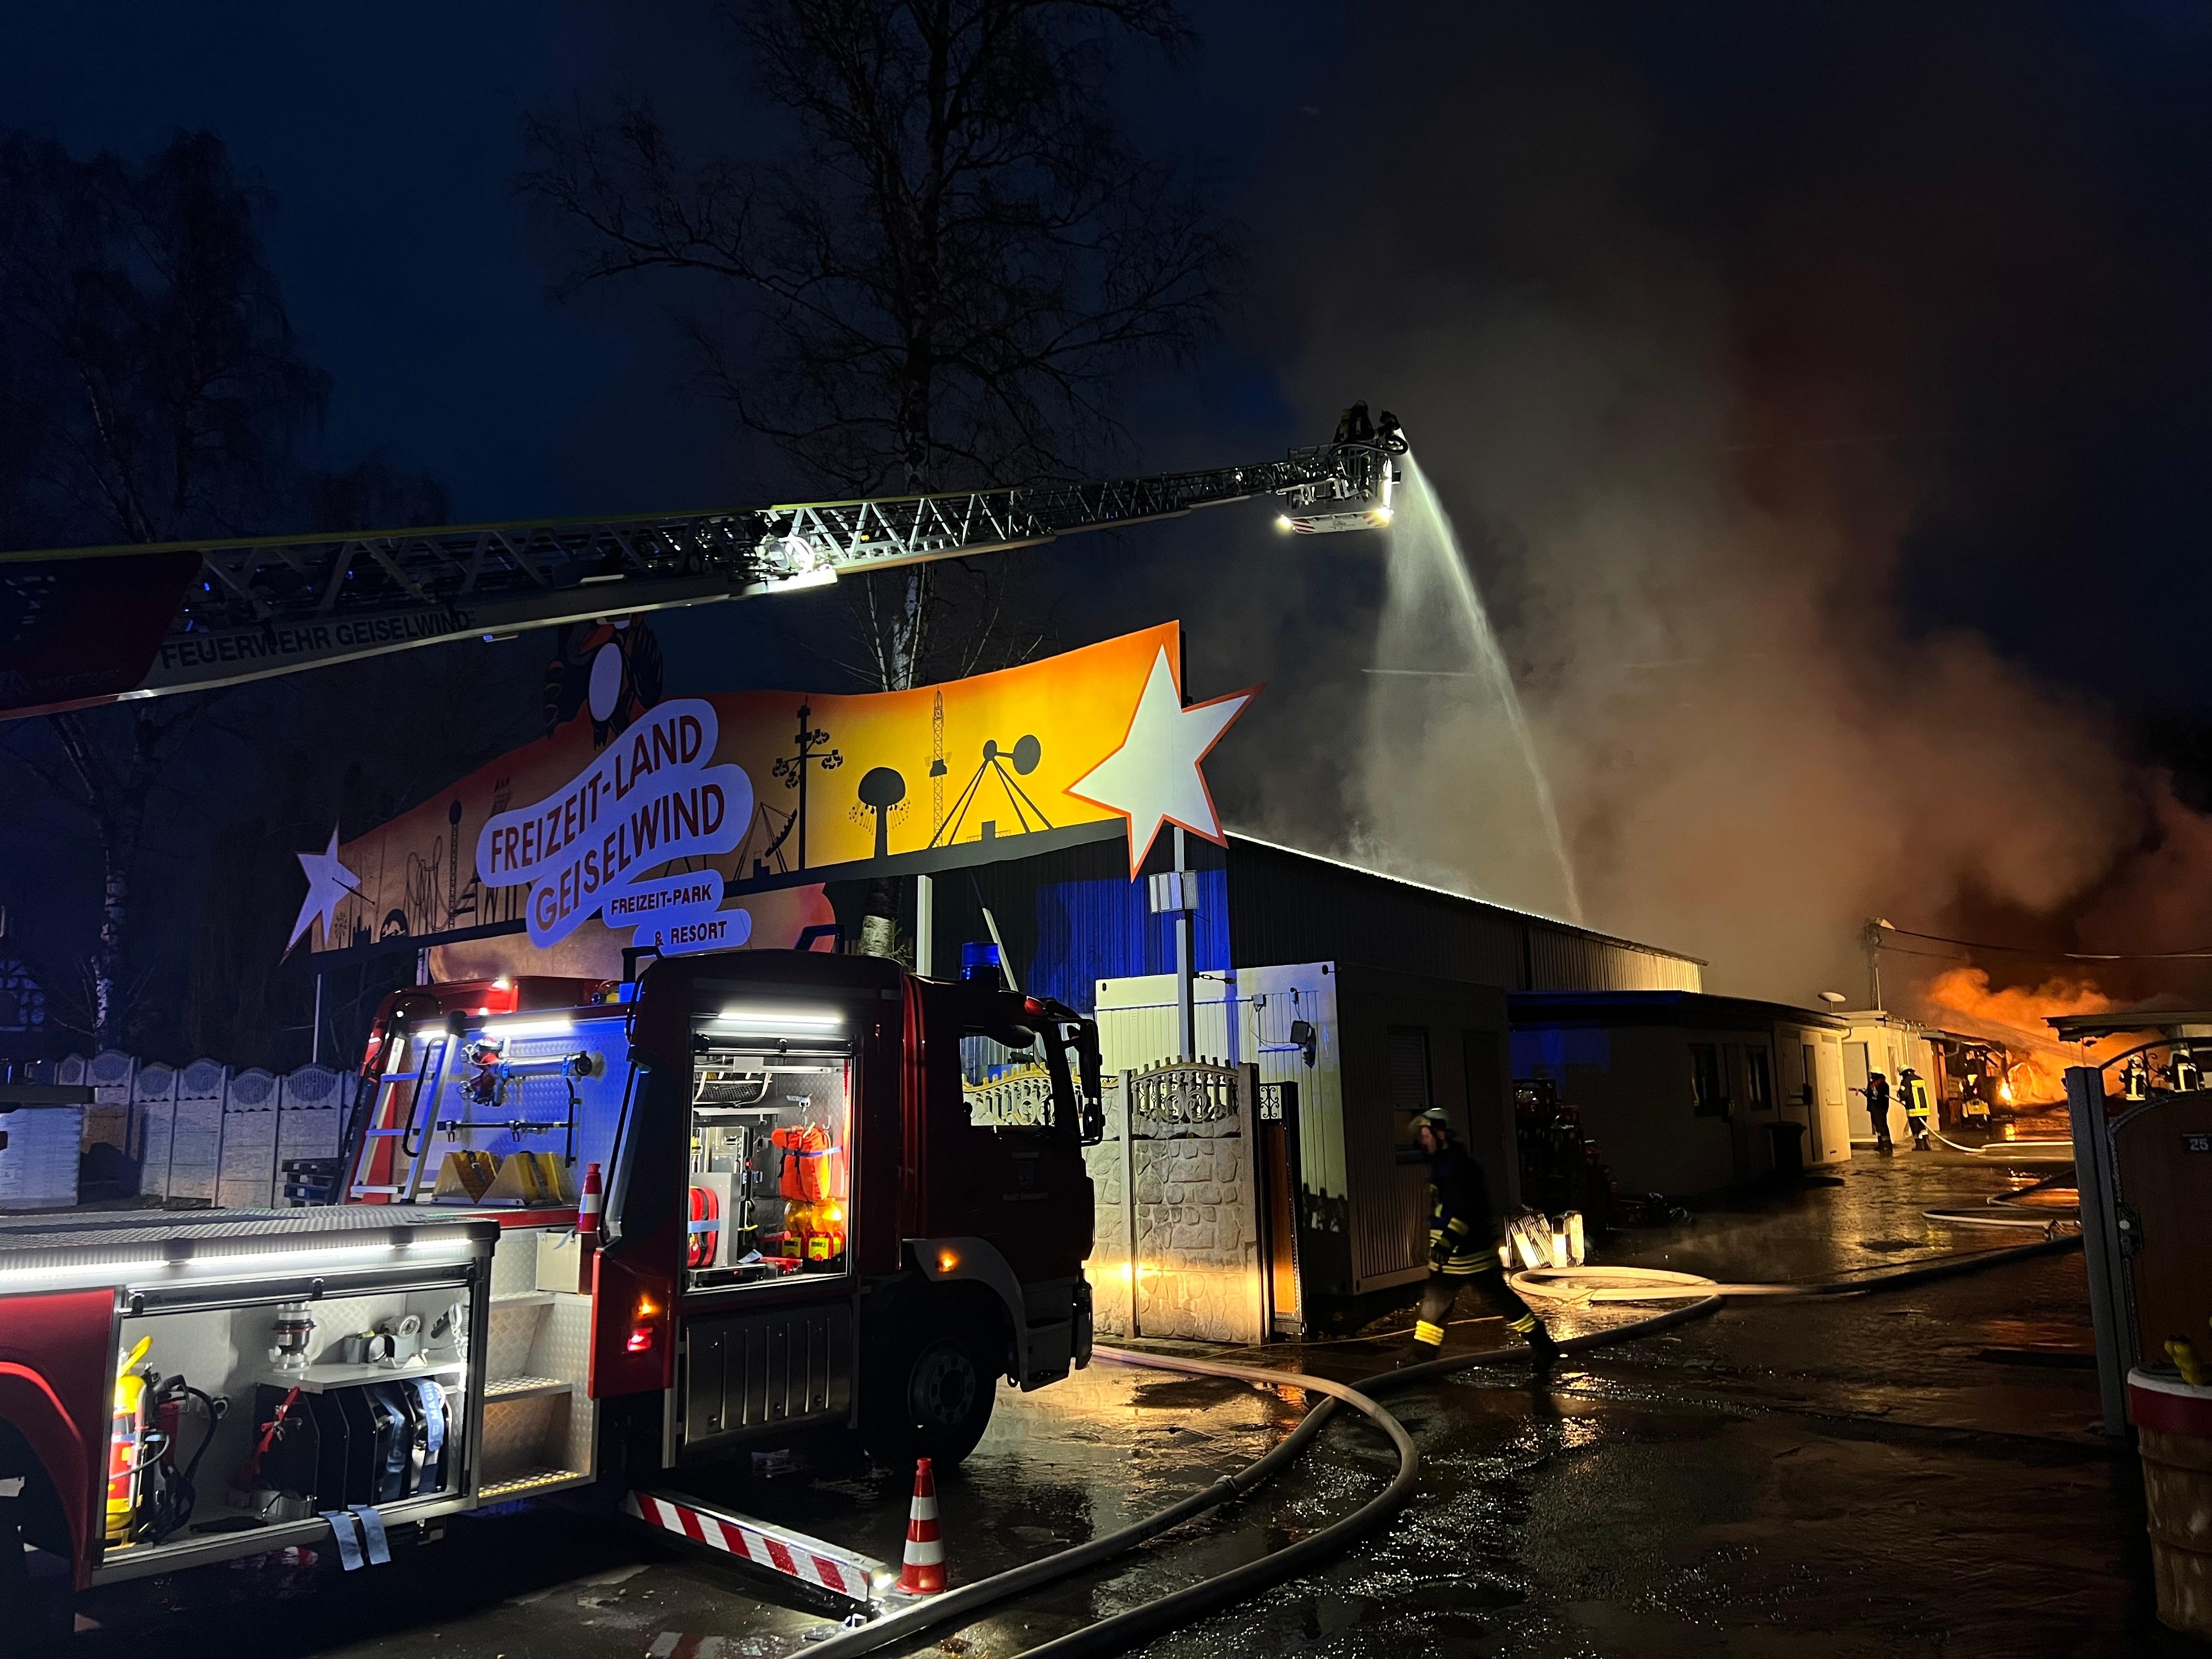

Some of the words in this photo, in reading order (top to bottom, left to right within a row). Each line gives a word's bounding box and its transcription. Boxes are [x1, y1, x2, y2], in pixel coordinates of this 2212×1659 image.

[162, 628, 331, 669] FEUERWEHR
[335, 611, 470, 646] GEISELWIND
[491, 715, 703, 874] FREIZEIT-LAND
[535, 783, 725, 932] GEISELWIND
[611, 883, 713, 916] FREIZEIT-PARK
[654, 930, 664, 947] &
[670, 920, 728, 945] RESORT
[2190, 1138, 2209, 1151] 25
